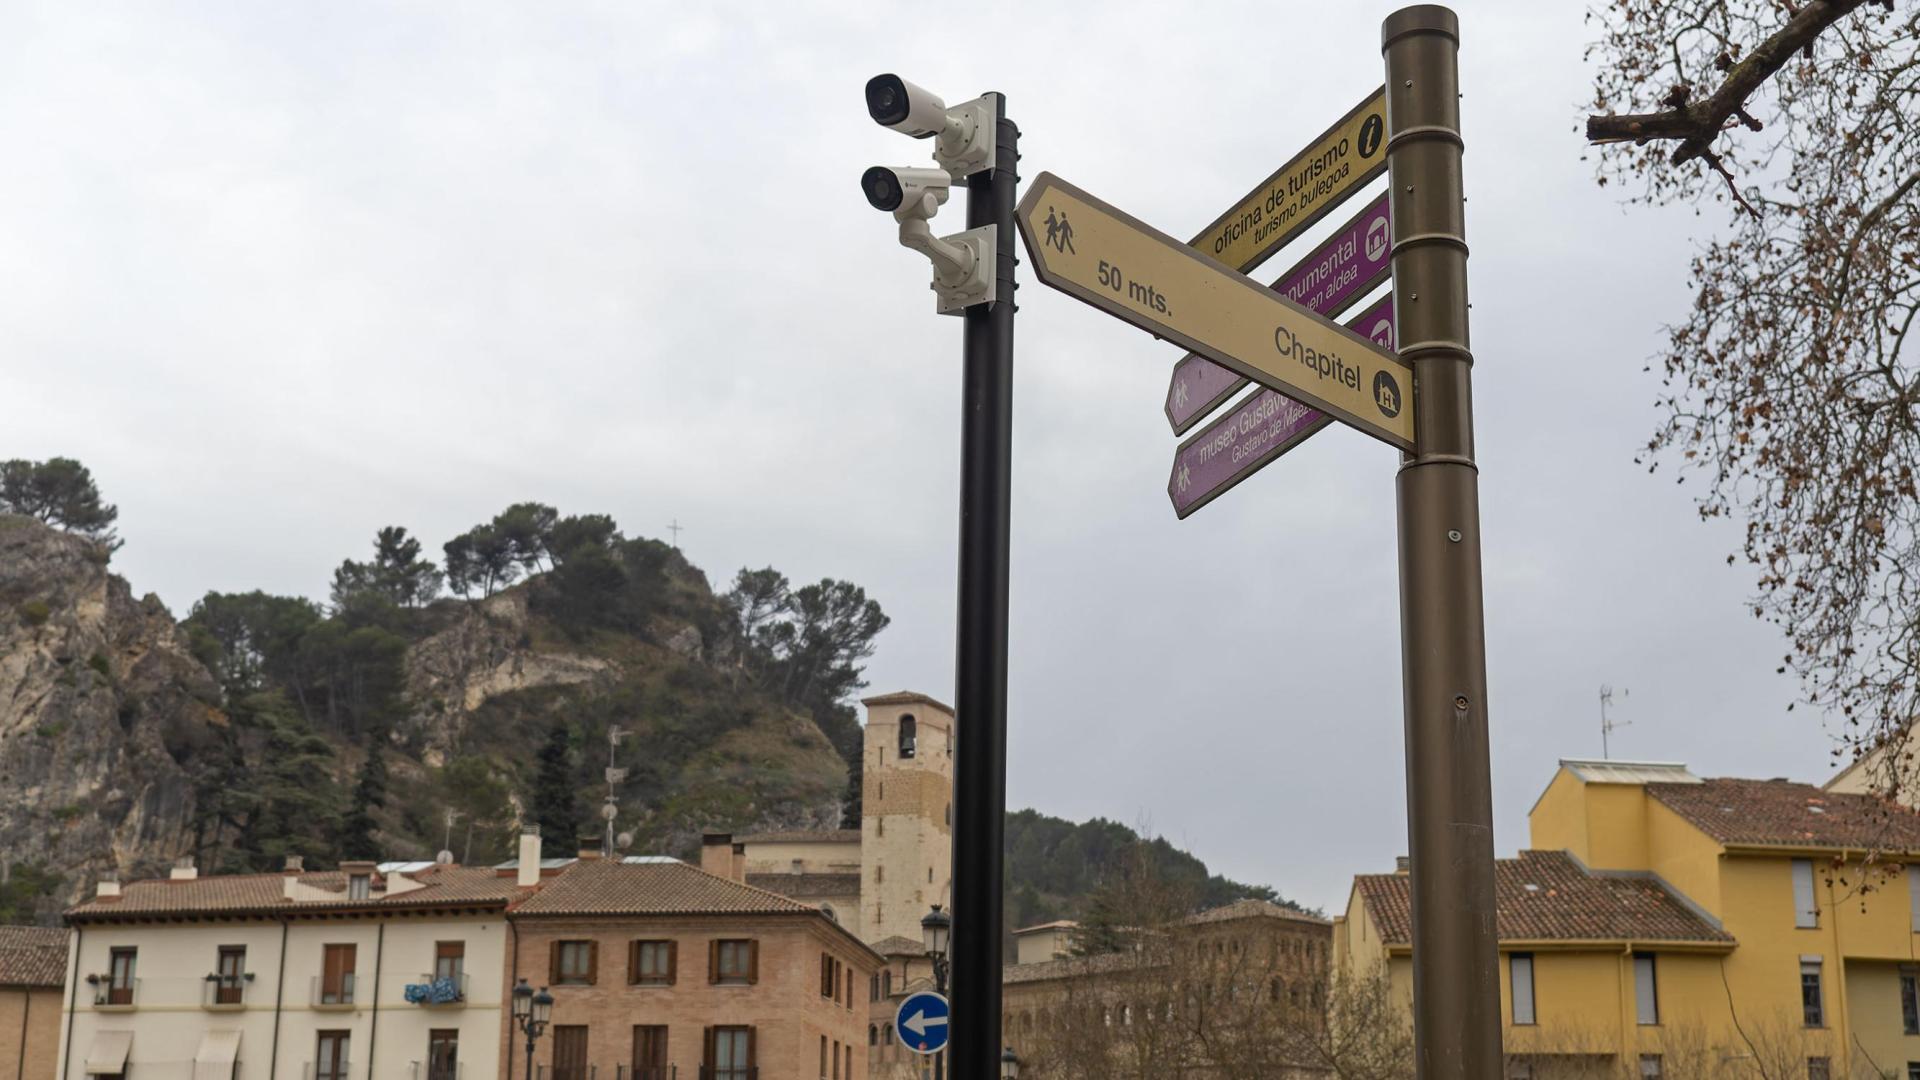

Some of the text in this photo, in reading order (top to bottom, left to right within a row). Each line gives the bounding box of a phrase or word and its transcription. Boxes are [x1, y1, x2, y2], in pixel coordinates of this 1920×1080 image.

[1215, 138, 1349, 254] oficina de turismo
[1254, 162, 1350, 245] turismo bulegoa
[1098, 260, 1172, 317] 50 mts.
[1326, 264, 1357, 299] aldea
[1275, 326, 1361, 392] Chapitel
[1200, 394, 1289, 465] museo Gustavo
[1231, 404, 1312, 463] Gustavo de Maez
